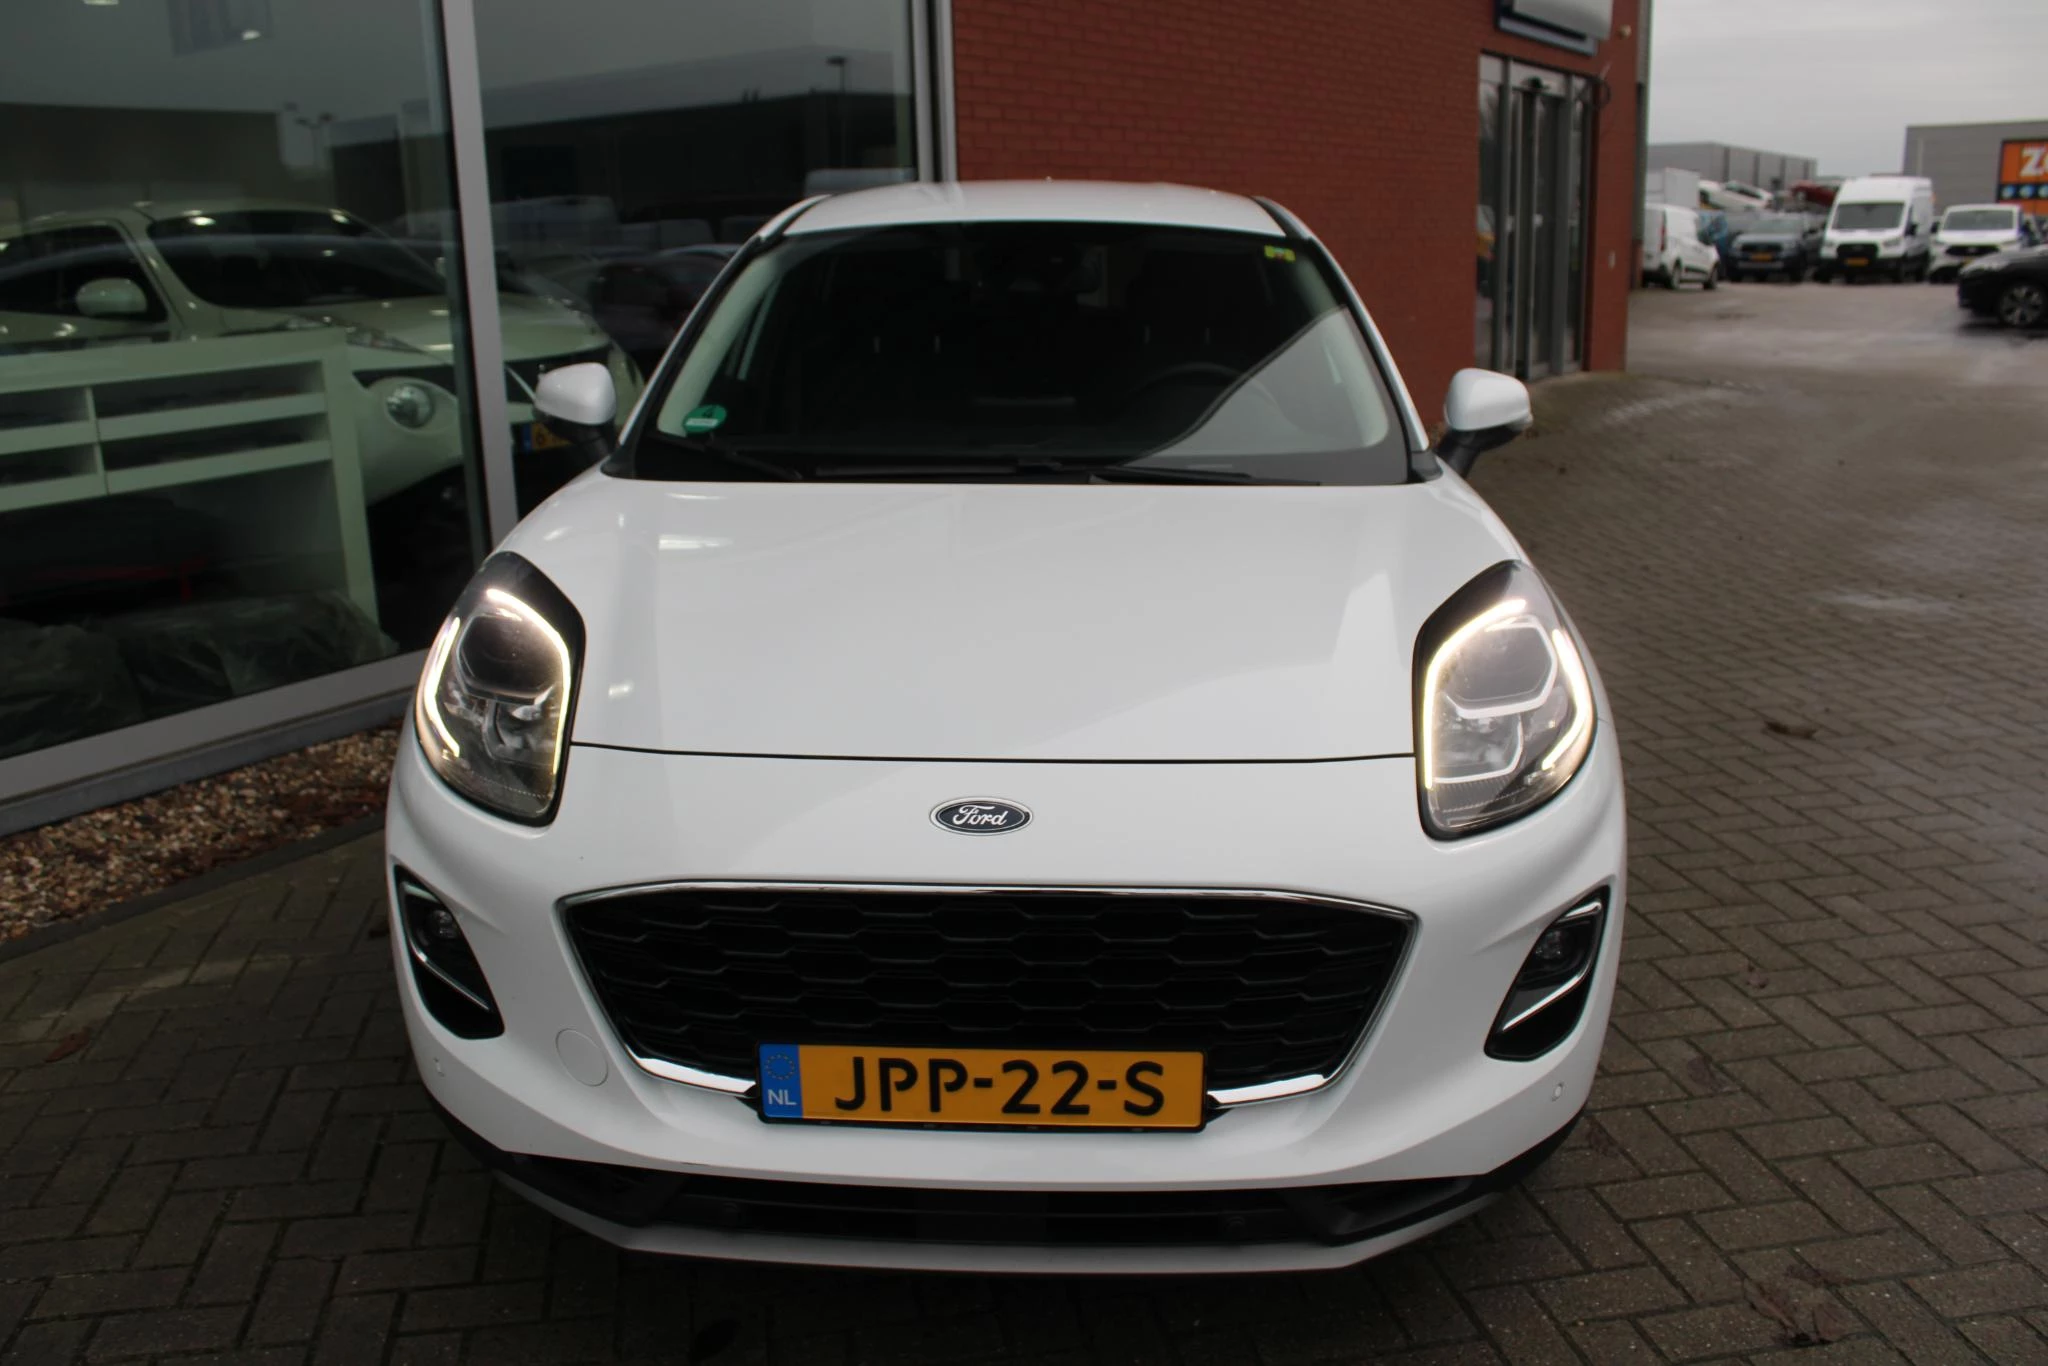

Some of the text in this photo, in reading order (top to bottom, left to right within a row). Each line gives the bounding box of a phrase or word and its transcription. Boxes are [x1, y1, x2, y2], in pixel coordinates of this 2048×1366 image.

[2020, 147, 2048, 176] Z
[952, 804, 1008, 826] Ford
[767, 1089, 797, 1106] NL
[834, 1056, 1165, 1117] JPP-22-S
